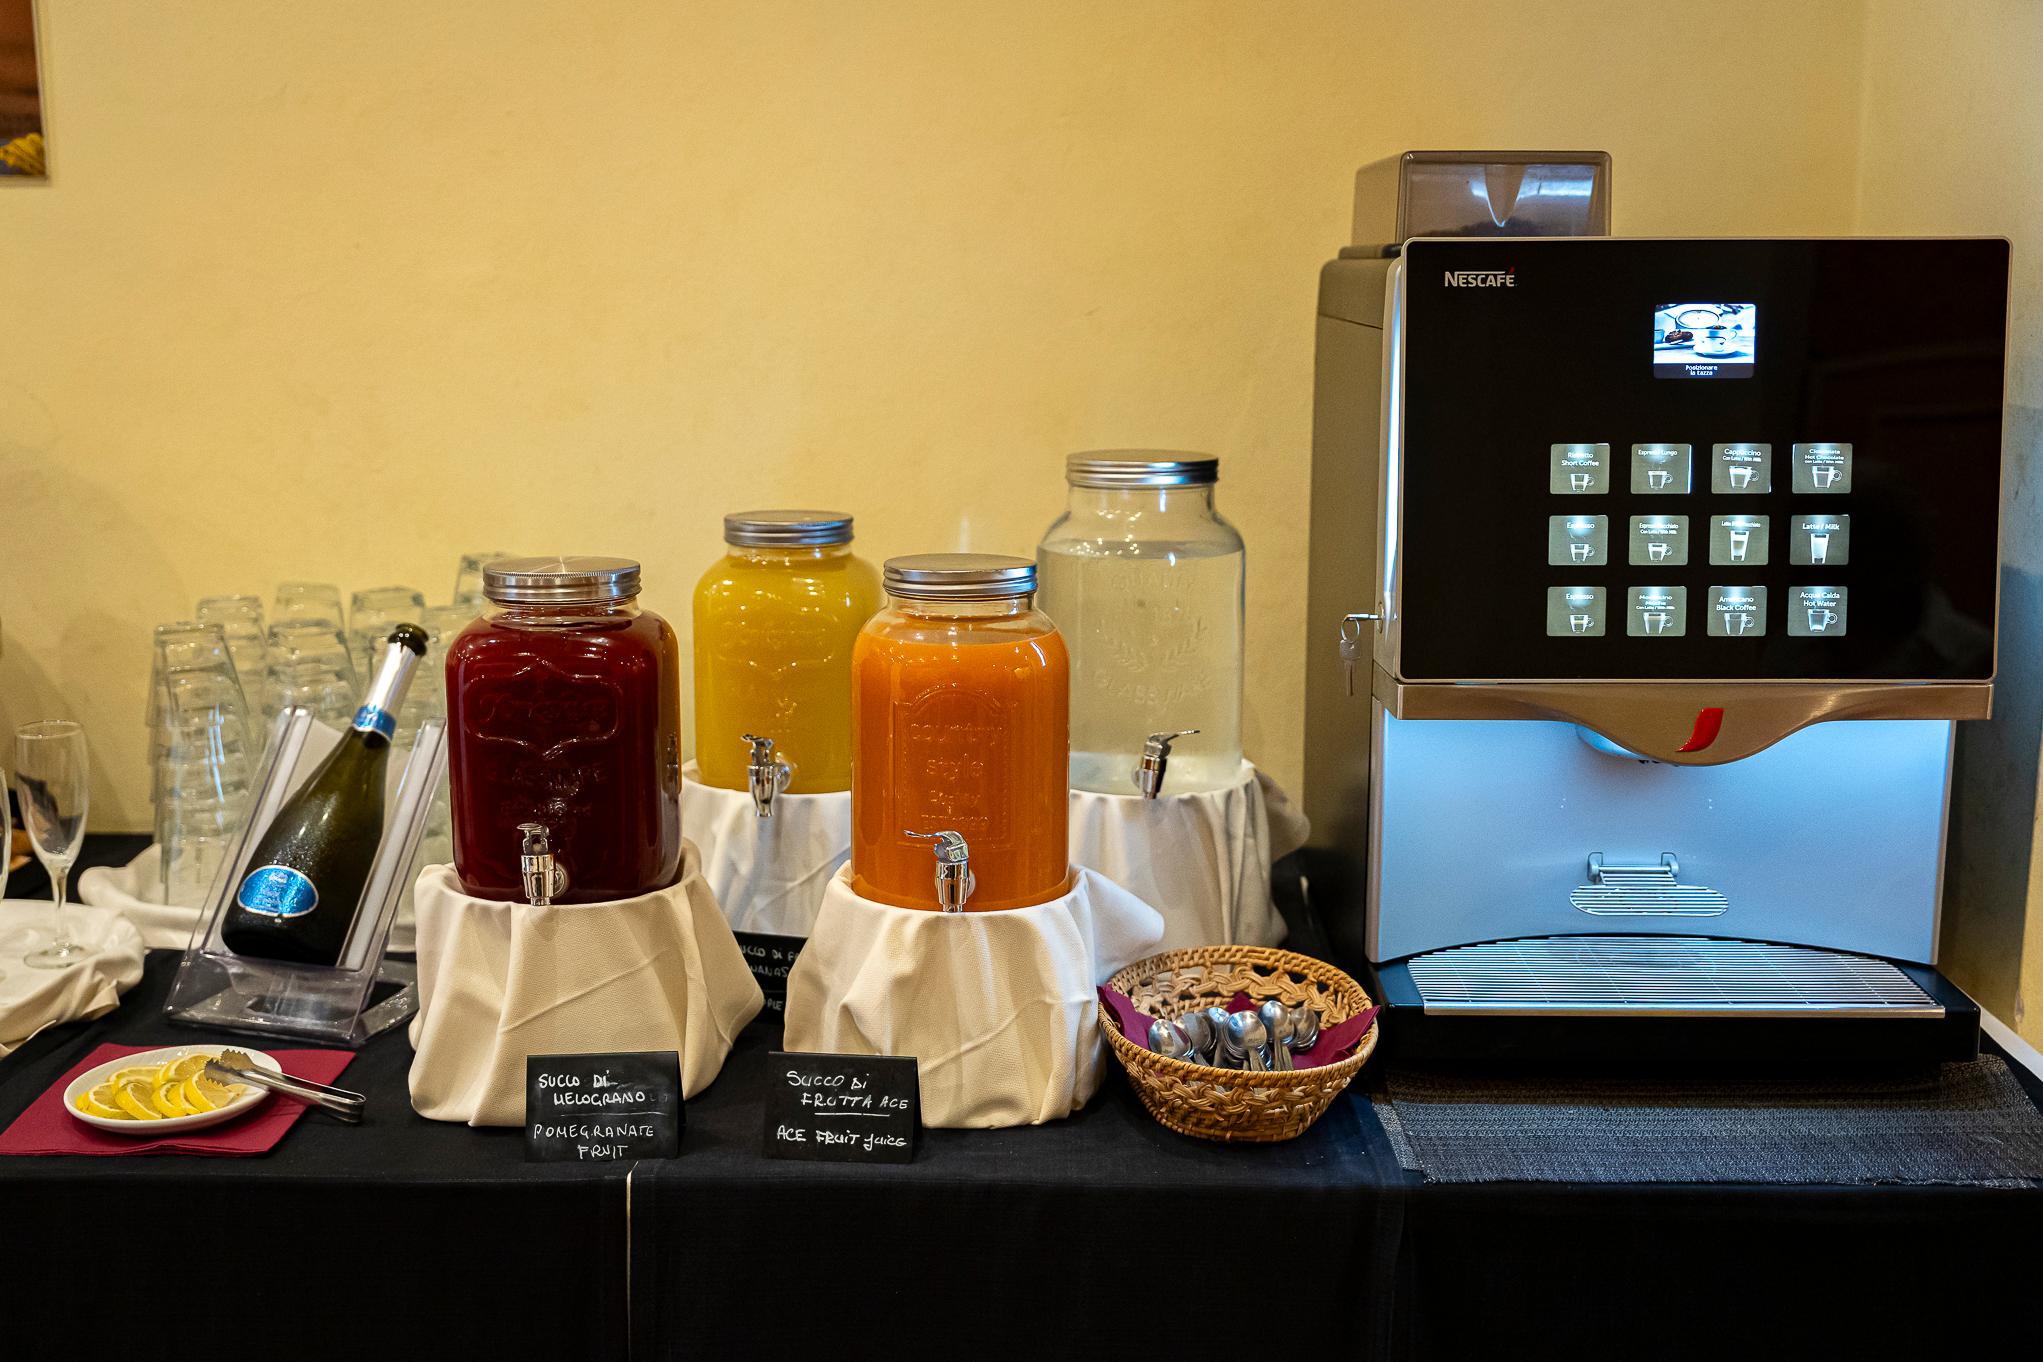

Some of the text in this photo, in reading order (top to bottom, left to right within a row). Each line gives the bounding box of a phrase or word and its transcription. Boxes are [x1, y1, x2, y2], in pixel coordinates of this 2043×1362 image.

[1724, 448, 1762, 457] Cappuccino
[1561, 459, 1600, 467] Short Coffee
[1824, 523, 1840, 531] Milk
[740, 945, 766, 958] UCCO
[538, 1073, 581, 1089] SUCCO
[879, 1095, 909, 1109] ACE
[776, 1124, 806, 1142] ACE
[577, 1144, 629, 1159] FRUIT
